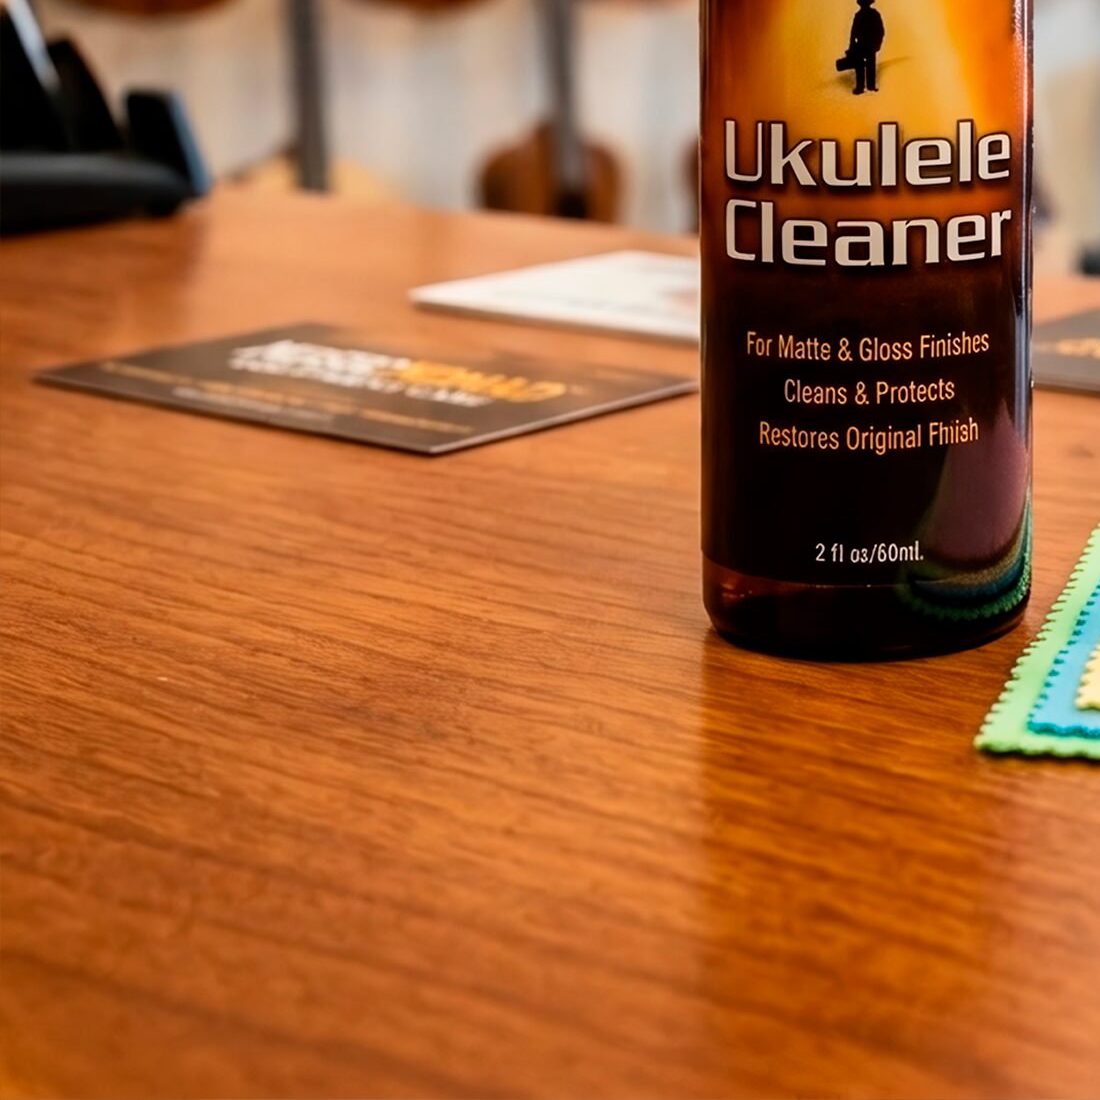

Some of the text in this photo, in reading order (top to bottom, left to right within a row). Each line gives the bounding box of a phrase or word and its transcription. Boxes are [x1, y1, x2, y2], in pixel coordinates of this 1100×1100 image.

[725, 119, 1011, 187] Ukulele
[725, 198, 1012, 267] Cleaner
[746, 331, 990, 361] For Matte & Gloss Finishes
[784, 378, 955, 405] Cleans & Protects
[758, 421, 839, 450] Restores
[845, 424, 921, 455] Original
[815, 543, 826, 562] 2
[830, 543, 844, 563] fl
